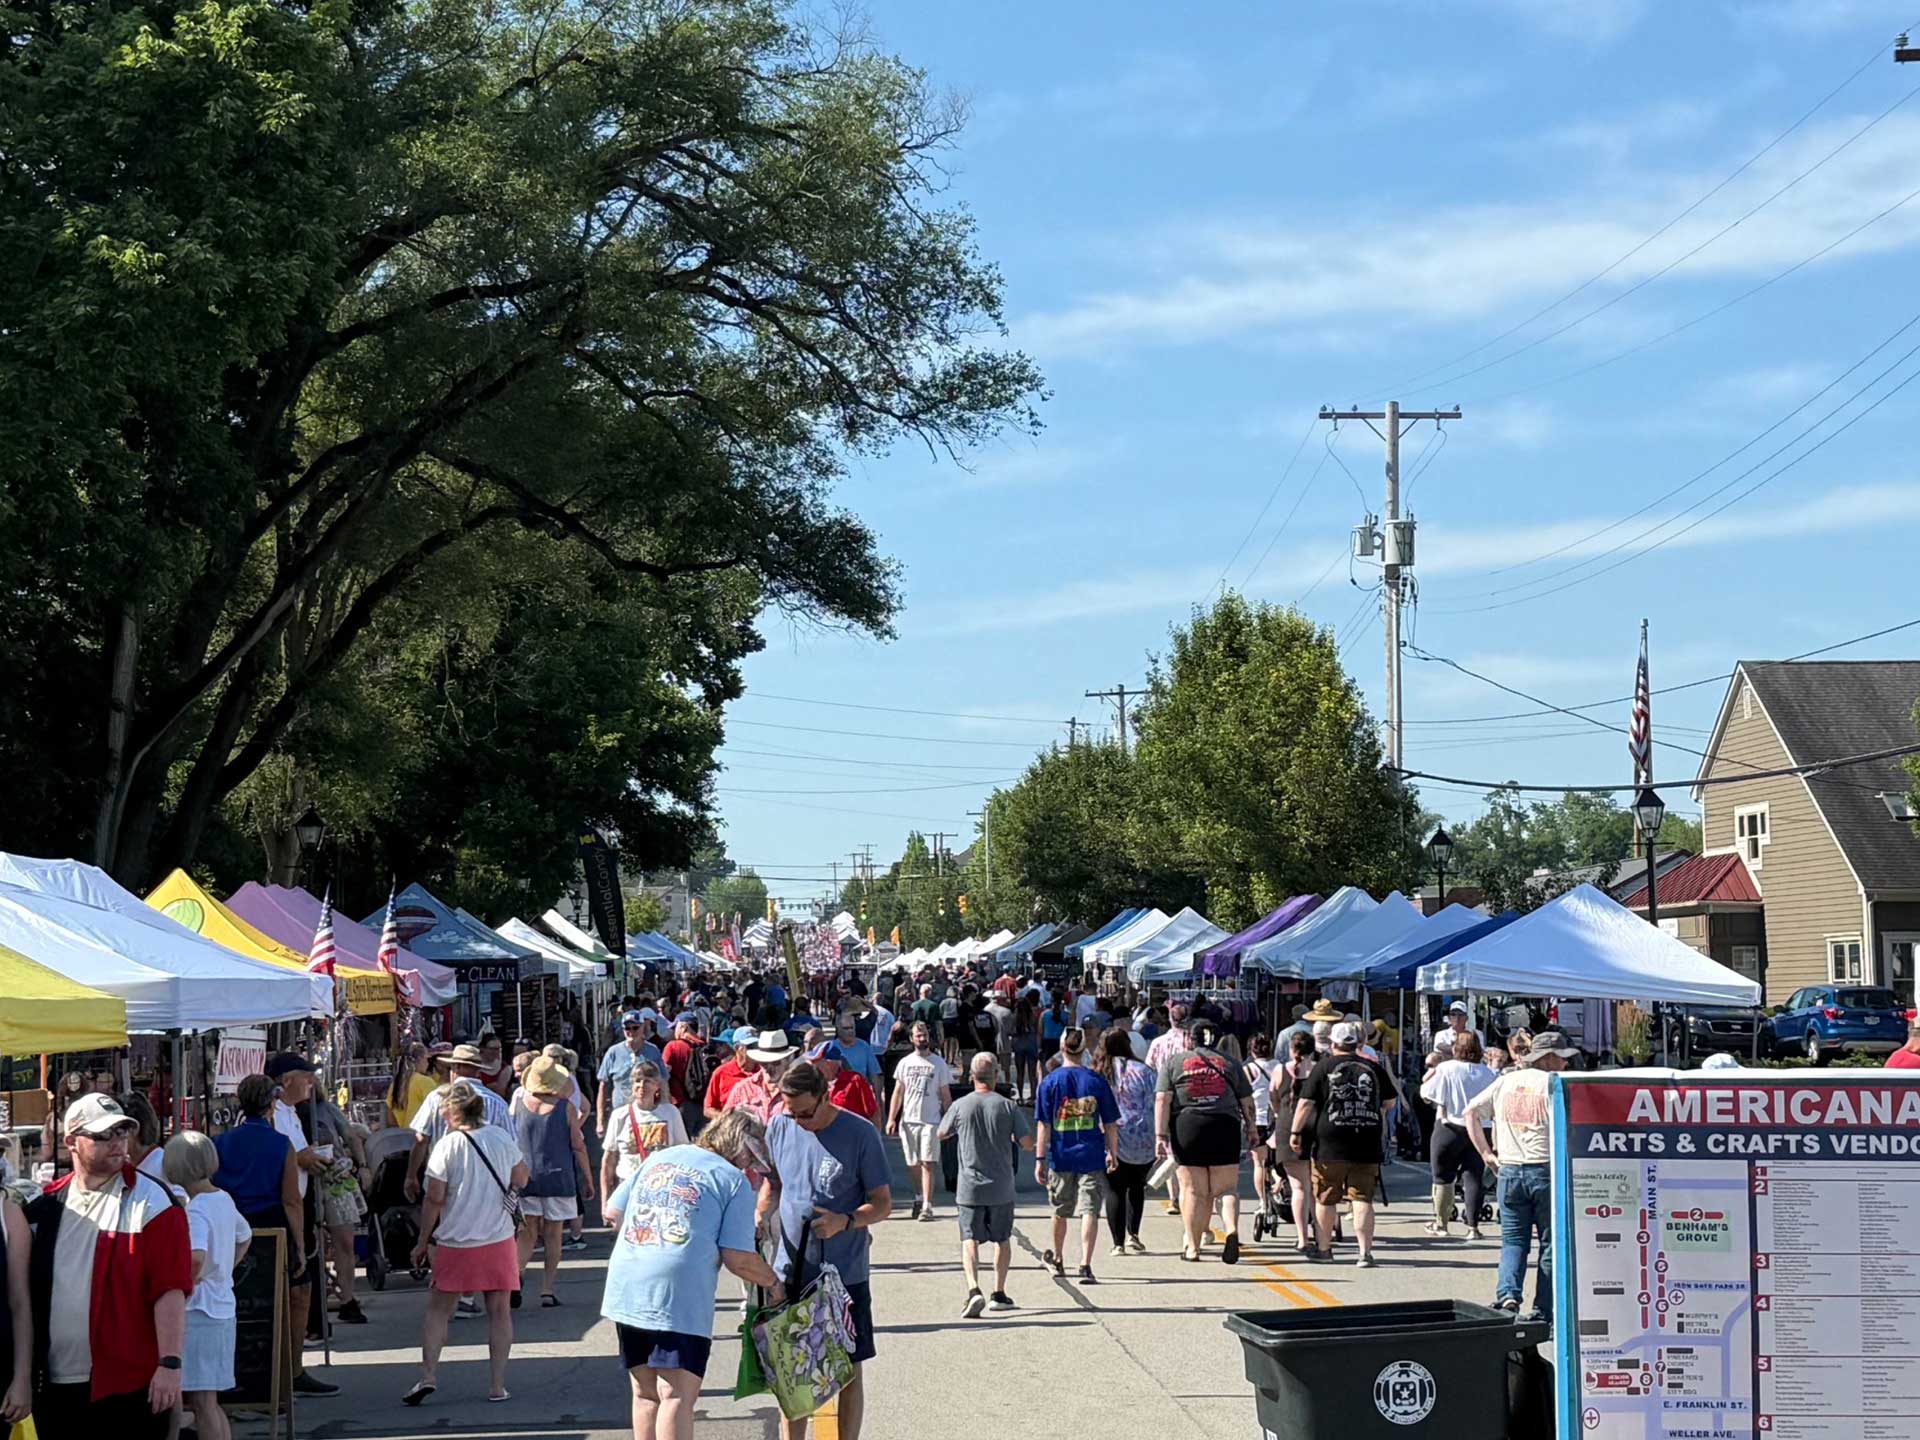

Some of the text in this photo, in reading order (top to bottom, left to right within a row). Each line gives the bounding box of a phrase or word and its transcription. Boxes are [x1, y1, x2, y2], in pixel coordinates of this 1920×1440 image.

[468, 966, 515, 982] CLEAN
[1626, 1089, 1920, 1125] AMERICANA
[1588, 1132, 1666, 1153] ARTS
[1676, 1133, 1696, 1153] &
[1706, 1133, 1820, 1154] CRAFTS
[1647, 1165, 1657, 1220] MAIN ST.
[1754, 1181, 1766, 1193] 2
[1676, 1233, 1718, 1243] GROVE
[1756, 1255, 1767, 1267] 3
[1756, 1297, 1768, 1309] 4
[1757, 1357, 1768, 1370] 5
[1676, 1401, 1727, 1409] FRANKLIN
[1758, 1416, 1769, 1429] 6
[1668, 1430, 1736, 1438] WELLER AVE.
